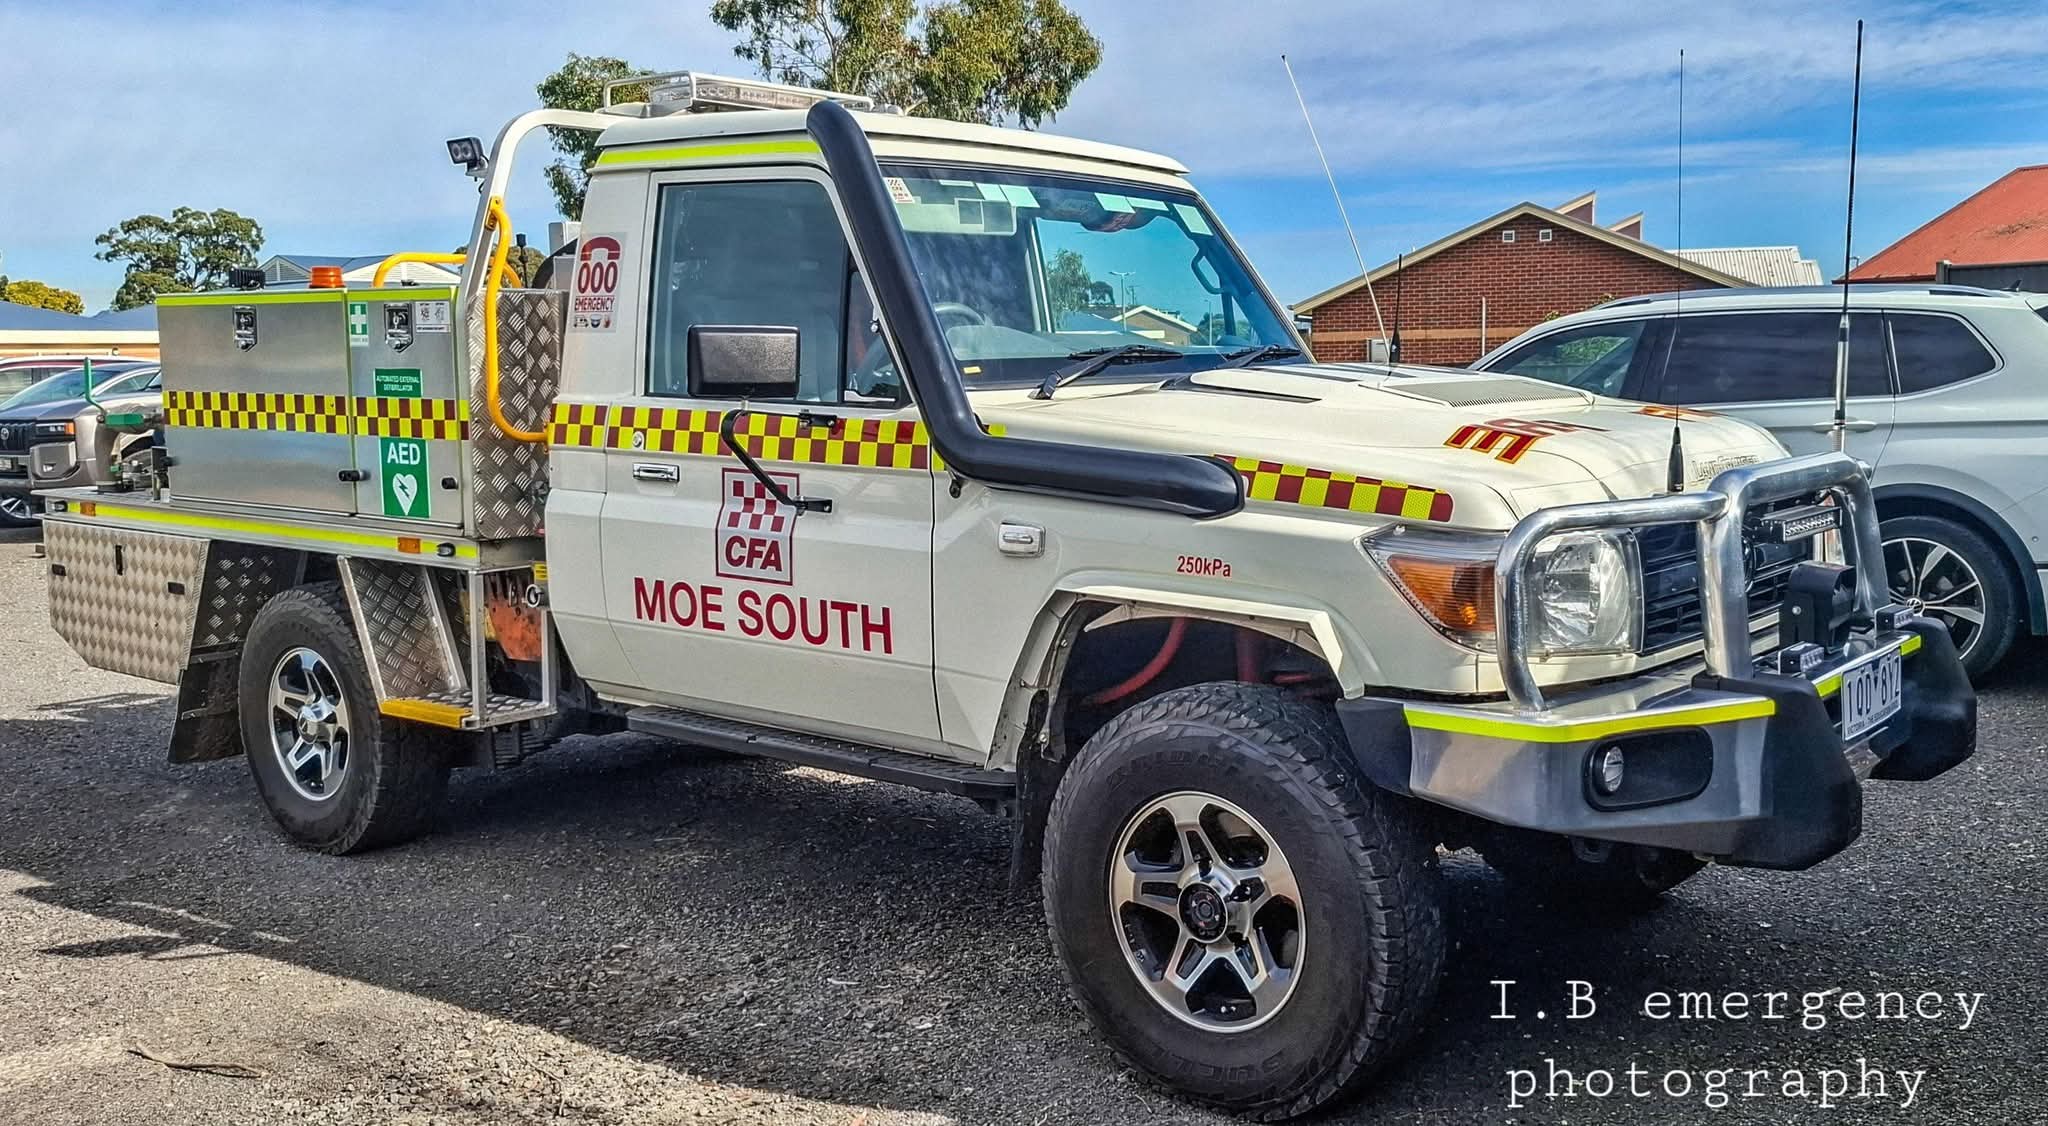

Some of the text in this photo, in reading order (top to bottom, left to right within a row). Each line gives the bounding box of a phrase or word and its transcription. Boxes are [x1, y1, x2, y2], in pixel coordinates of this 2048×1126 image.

[578, 261, 618, 294] 000
[575, 297, 615, 311] EMERGENCY
[387, 442, 421, 465] AED
[725, 535, 783, 572] CFA
[1176, 555, 1232, 577] 250kPa
[634, 577, 893, 655] MOE SOUTH
